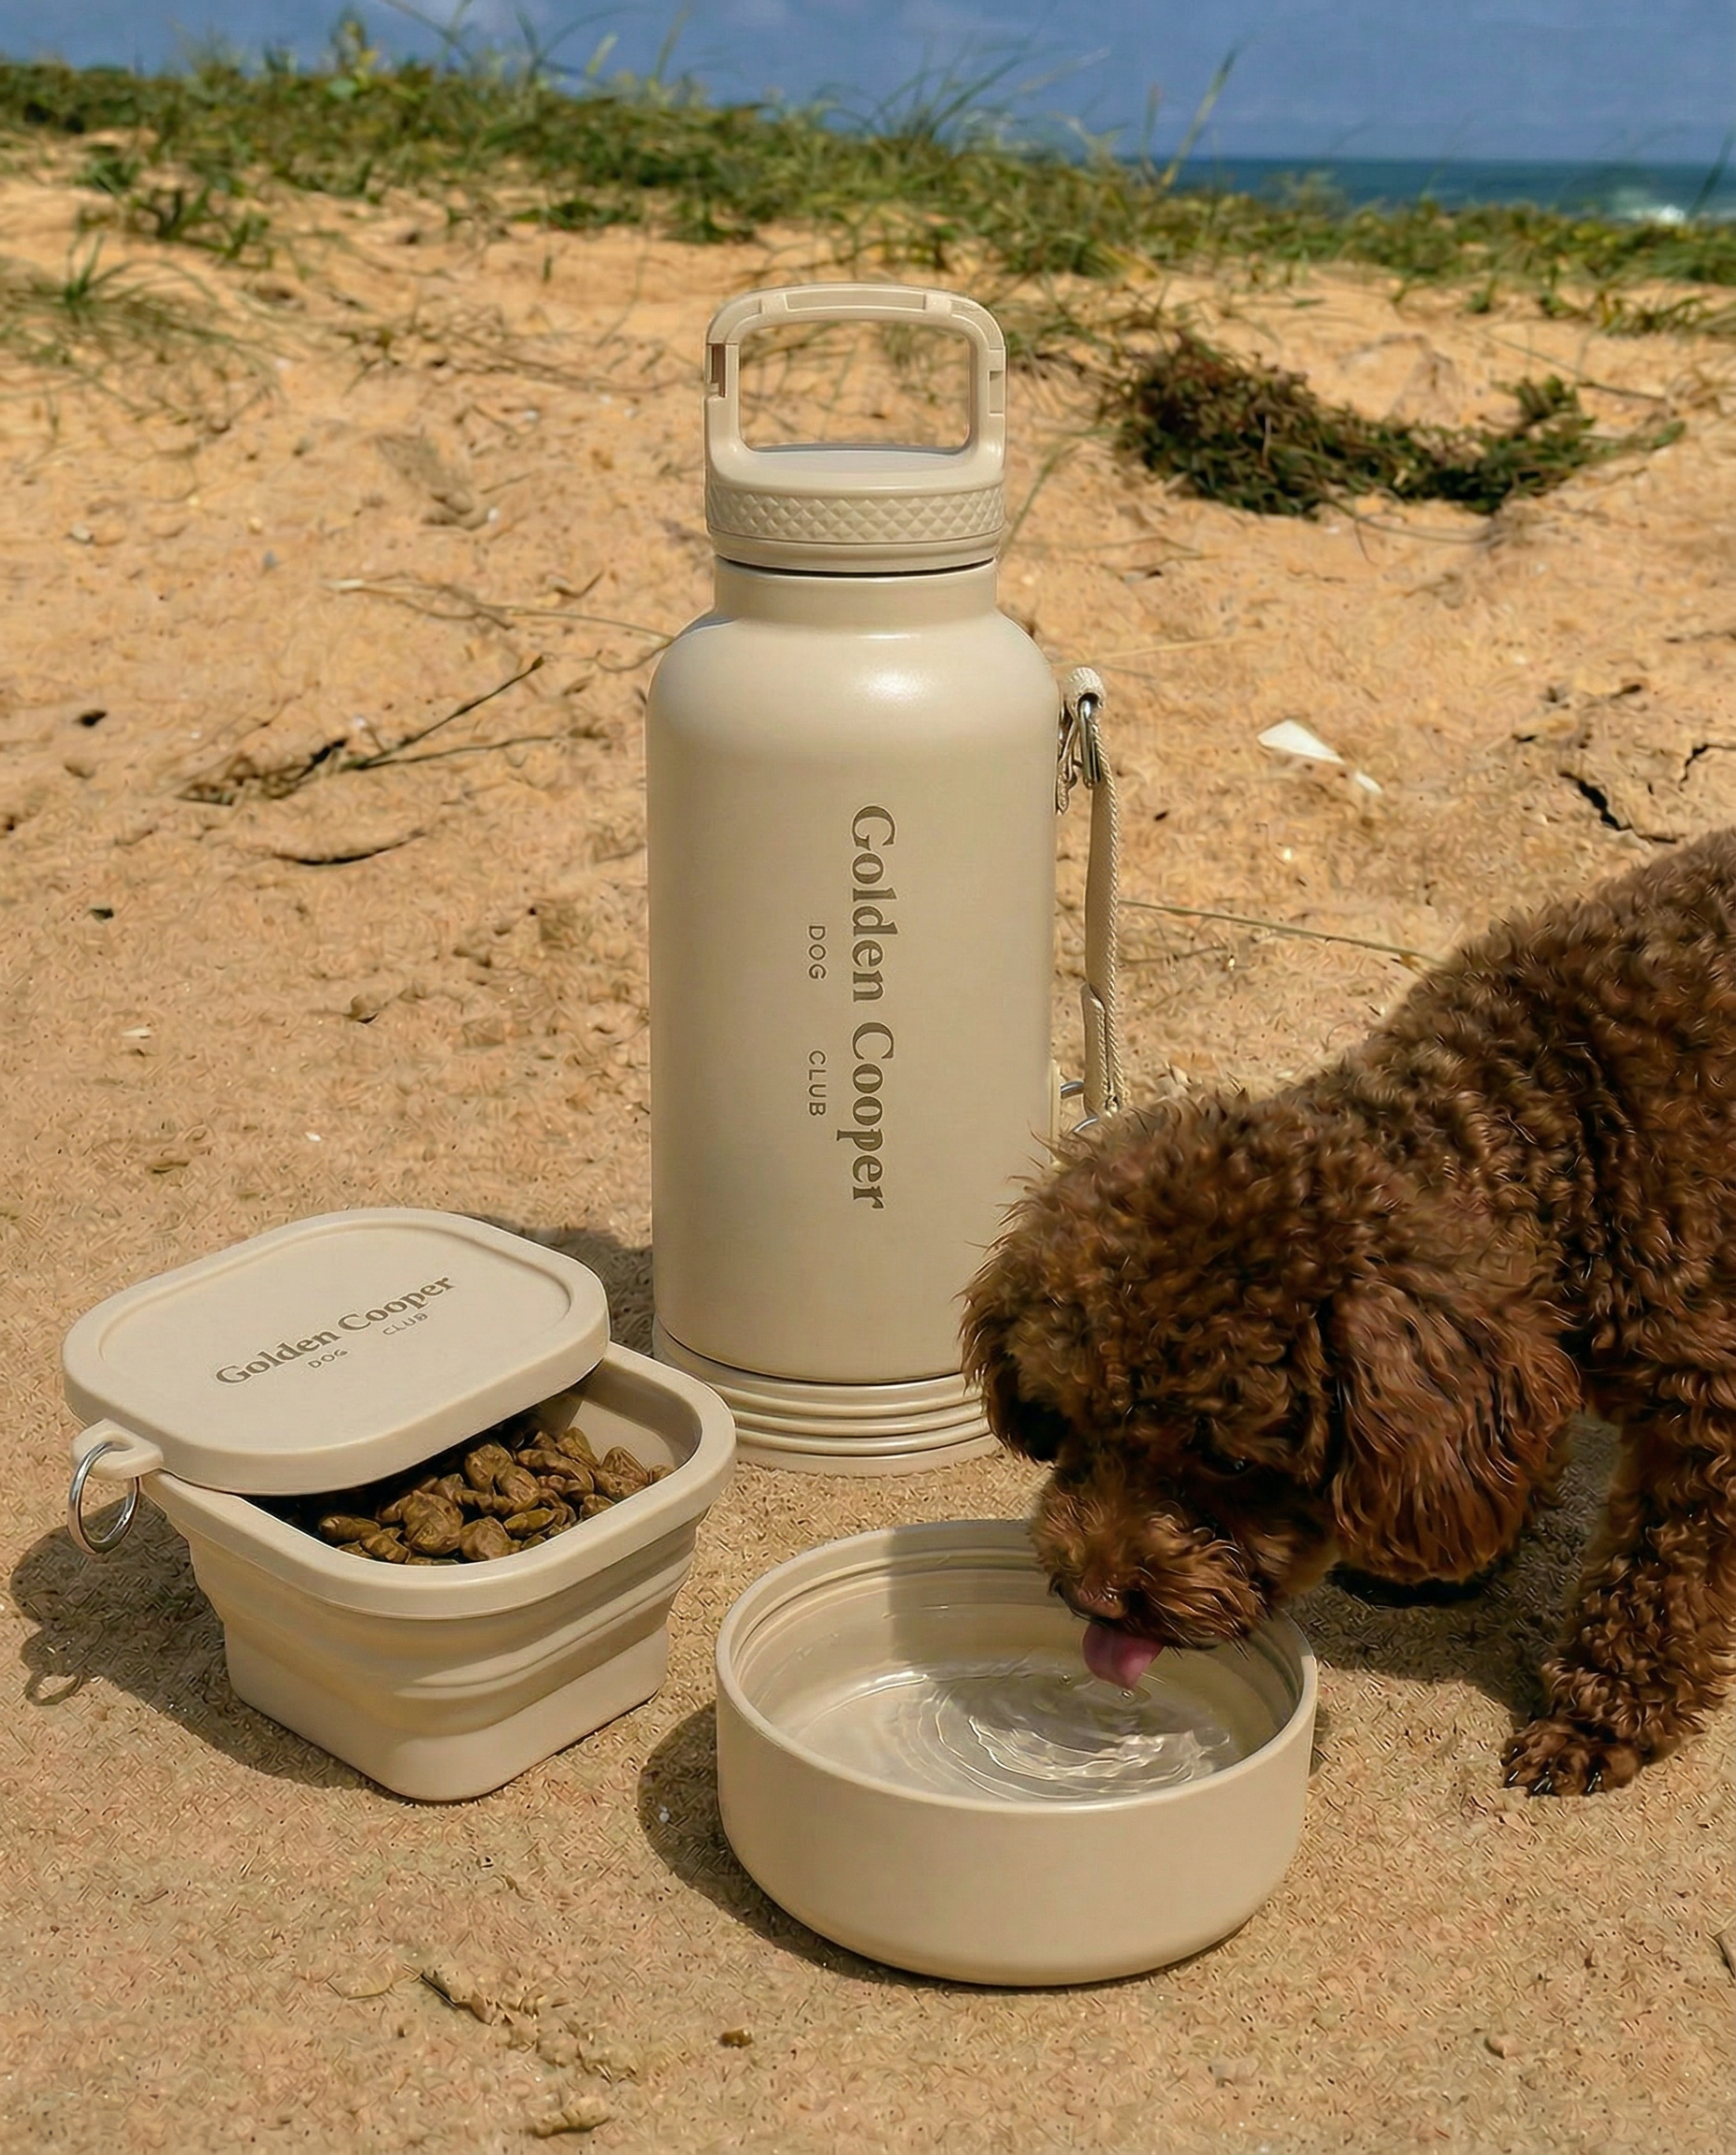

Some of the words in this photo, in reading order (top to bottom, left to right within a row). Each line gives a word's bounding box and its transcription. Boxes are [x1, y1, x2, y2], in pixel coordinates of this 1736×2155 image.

[852, 804, 898, 1004] Golden
[807, 924, 827, 980] DOG
[807, 1049, 827, 1117] CLUB
[836, 1021, 895, 1209] Cooper
[215, 1328, 341, 1384] Golden
[338, 1276, 456, 1331] Cooper
[307, 1349, 349, 1368] DOG
